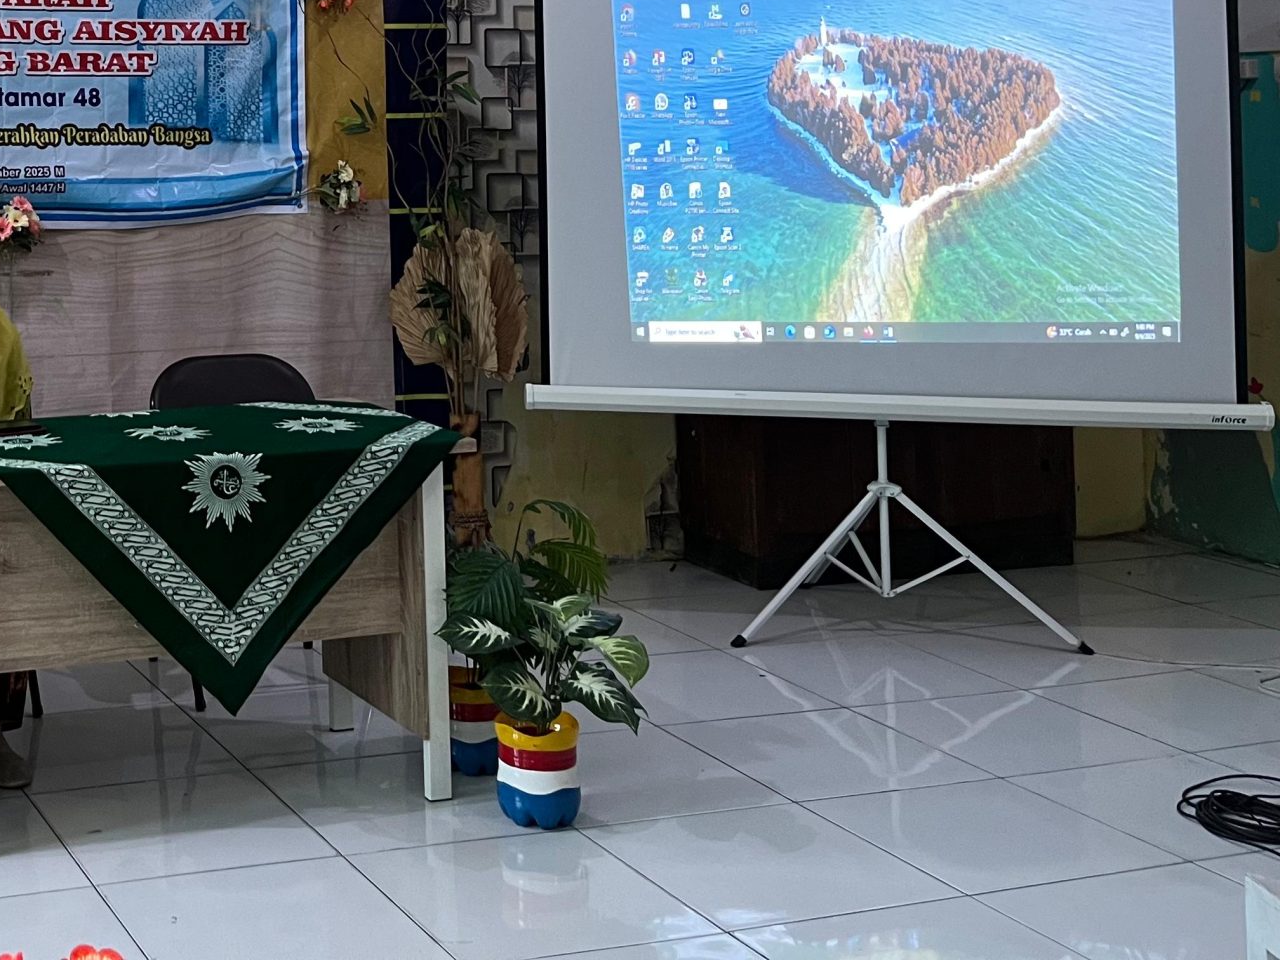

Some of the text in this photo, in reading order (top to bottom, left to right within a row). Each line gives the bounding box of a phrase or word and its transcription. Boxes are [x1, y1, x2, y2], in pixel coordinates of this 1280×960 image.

[72, 20, 248, 43] AISYIYAH
[26, 52, 155, 74] BARAT
[73, 88, 101, 107] 48
[62, 125, 149, 145] Peradaban
[151, 126, 211, 147] Bangsa
[25, 166, 50, 177] 2025
[55, 166, 65, 177] M
[1, 183, 27, 194] Awal
[30, 183, 53, 193] 1447
[55, 182, 65, 192] H
